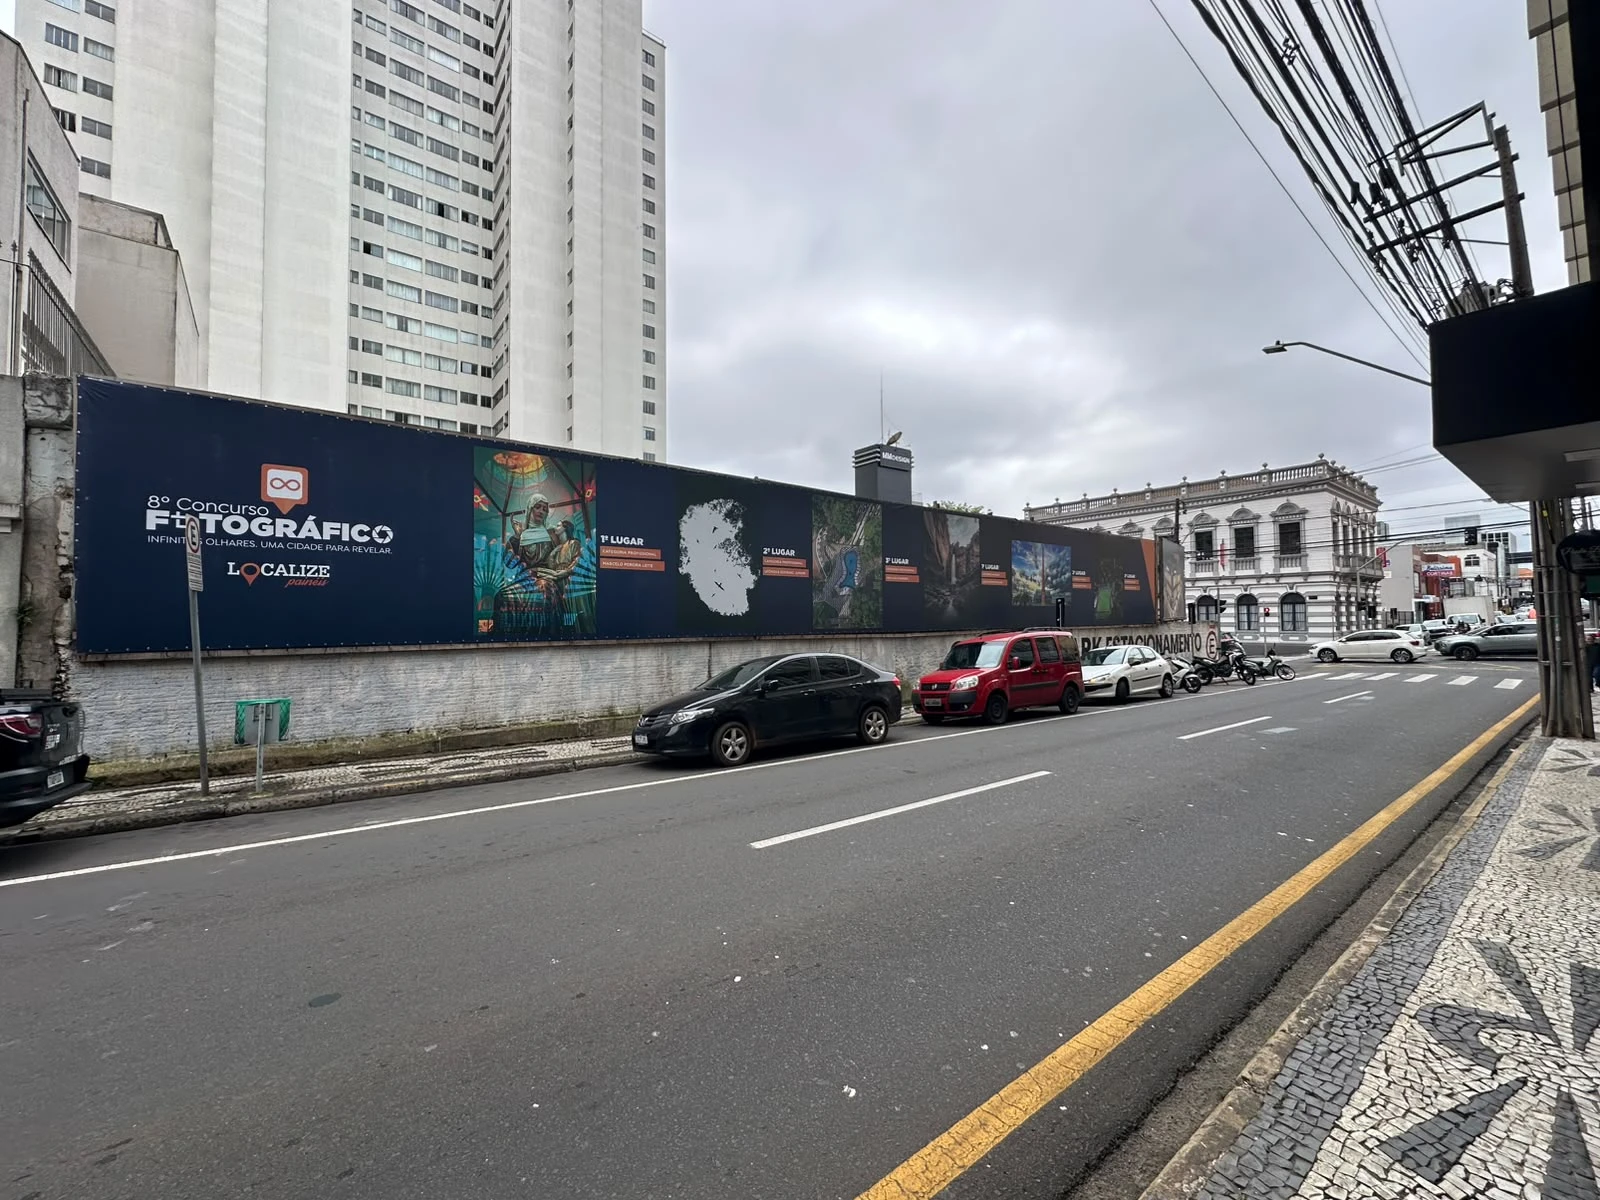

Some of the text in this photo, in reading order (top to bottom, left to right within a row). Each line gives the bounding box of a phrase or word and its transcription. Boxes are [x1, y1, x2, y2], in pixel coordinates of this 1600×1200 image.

[176, 497, 269, 516] Concurso
[147, 535, 393, 554] INFINITS OLHARES. UMA CIDADE PARA REVELAR.
[610, 536, 644, 546] LUGAR
[771, 548, 795, 556] LUGAR
[227, 561, 330, 583] LOCALIZE
